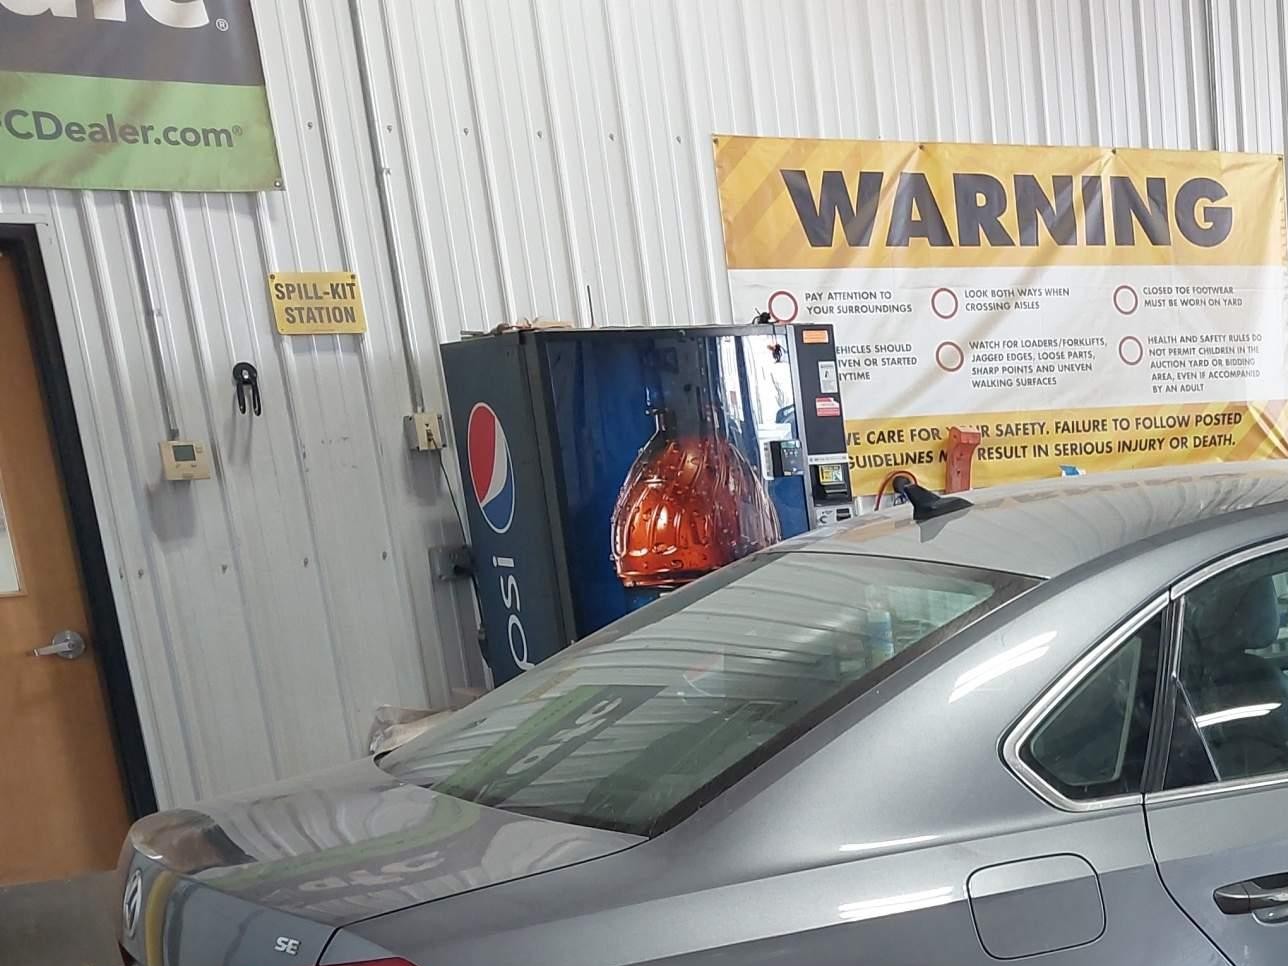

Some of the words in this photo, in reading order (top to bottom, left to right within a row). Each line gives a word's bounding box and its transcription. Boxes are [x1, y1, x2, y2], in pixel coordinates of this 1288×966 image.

[780, 169, 1233, 248] WARNING
[274, 283, 356, 300] SPILL-KIT
[805, 292, 823, 301] PAY
[827, 291, 877, 300] ATTENTION
[880, 291, 892, 300] TO
[964, 289, 988, 299] LOOK
[991, 288, 1015, 298] BOTH
[1017, 288, 1043, 297] WAYS
[1045, 287, 1070, 297] WHEN
[1143, 286, 1173, 295] CLOSED
[1175, 286, 1190, 295] TOE
[1192, 286, 1234, 295] FOOTWEAR
[965, 302, 1011, 312] CROSSING
[1014, 301, 1040, 310] AISLES
[1144, 299, 1166, 308] MUST
[1168, 299, 1178, 307] BE
[1180, 299, 1206, 307] WORN
[1208, 298, 1221, 307] ON
[1223, 298, 1243, 306] YARD
[284, 306, 357, 324] STATION
[806, 306, 834, 315] YOUR
[836, 304, 913, 314] SURROUNDINGS
[969, 340, 1000, 350] WATCH
[1002, 340, 1019, 349] FOR
[1021, 337, 1108, 349] LOADERS/FORKLIFTS,
[1147, 335, 1177, 345] HEALTH
[1179, 335, 1198, 344] AND
[1200, 334, 1227, 343] SAFETY
[1228, 334, 1250, 343] RULES
[1252, 334, 1262, 342] DO
[836, 345, 871, 355] EHICLES
[874, 344, 912, 353] SHOULD
[1149, 348, 1166, 357] NOT
[1168, 347, 1196, 356] PERMIT
[1198, 347, 1235, 355] CHILDREN
[1237, 346, 1246, 354] IN
[1247, 346, 1260, 354] THE
[838, 359, 861, 368] IVEN
[864, 358, 878, 367] OR
[881, 356, 918, 366] STARTED
[971, 353, 1004, 363] JAGGED
[1006, 352, 1036, 362] EDGES,
[1038, 351, 1065, 361] LOOSE
[1067, 350, 1096, 361] PARTS,
[971, 366, 1000, 376] SHARP
[1002, 365, 1033, 374] POINTS
[1036, 364, 1055, 373] AND
[1057, 363, 1093, 372] UNEVEN
[1150, 360, 1186, 369] AUCTION
[1188, 359, 1209, 368] YARD
[1211, 359, 1223, 367] OR
[1225, 358, 1256, 366] BIDDING
[839, 372, 871, 381] YTIME
[1151, 373, 1175, 382] AREA,
[1177, 372, 1197, 380] EVEN
[1200, 371, 1206, 380] IF
[1208, 369, 1261, 380] ACCOMPANIED
[971, 379, 1013, 389] WALKING
[1015, 377, 1057, 387] SURFACES
[1152, 385, 1163, 393] BY
[1165, 385, 1178, 393] AN
[1180, 384, 1204, 393] ADULT
[866, 430, 905, 445] CARE
[910, 427, 942, 442] FOR
[995, 420, 1050, 437] SAFETY.
[1055, 418, 1108, 434] FAILURE
[1112, 417, 1130, 431] TO
[1135, 415, 1191, 430] FOLLOW
[1195, 412, 1242, 427] POSTED
[977, 445, 1027, 462] RESULT
[1033, 444, 1049, 458] IN
[1054, 441, 1113, 457] SERIOUS
[1117, 437, 1166, 453] INJURY
[1169, 436, 1188, 450] OR
[1193, 433, 1236, 449] DEATH.
[274, 936, 300, 955] SE
